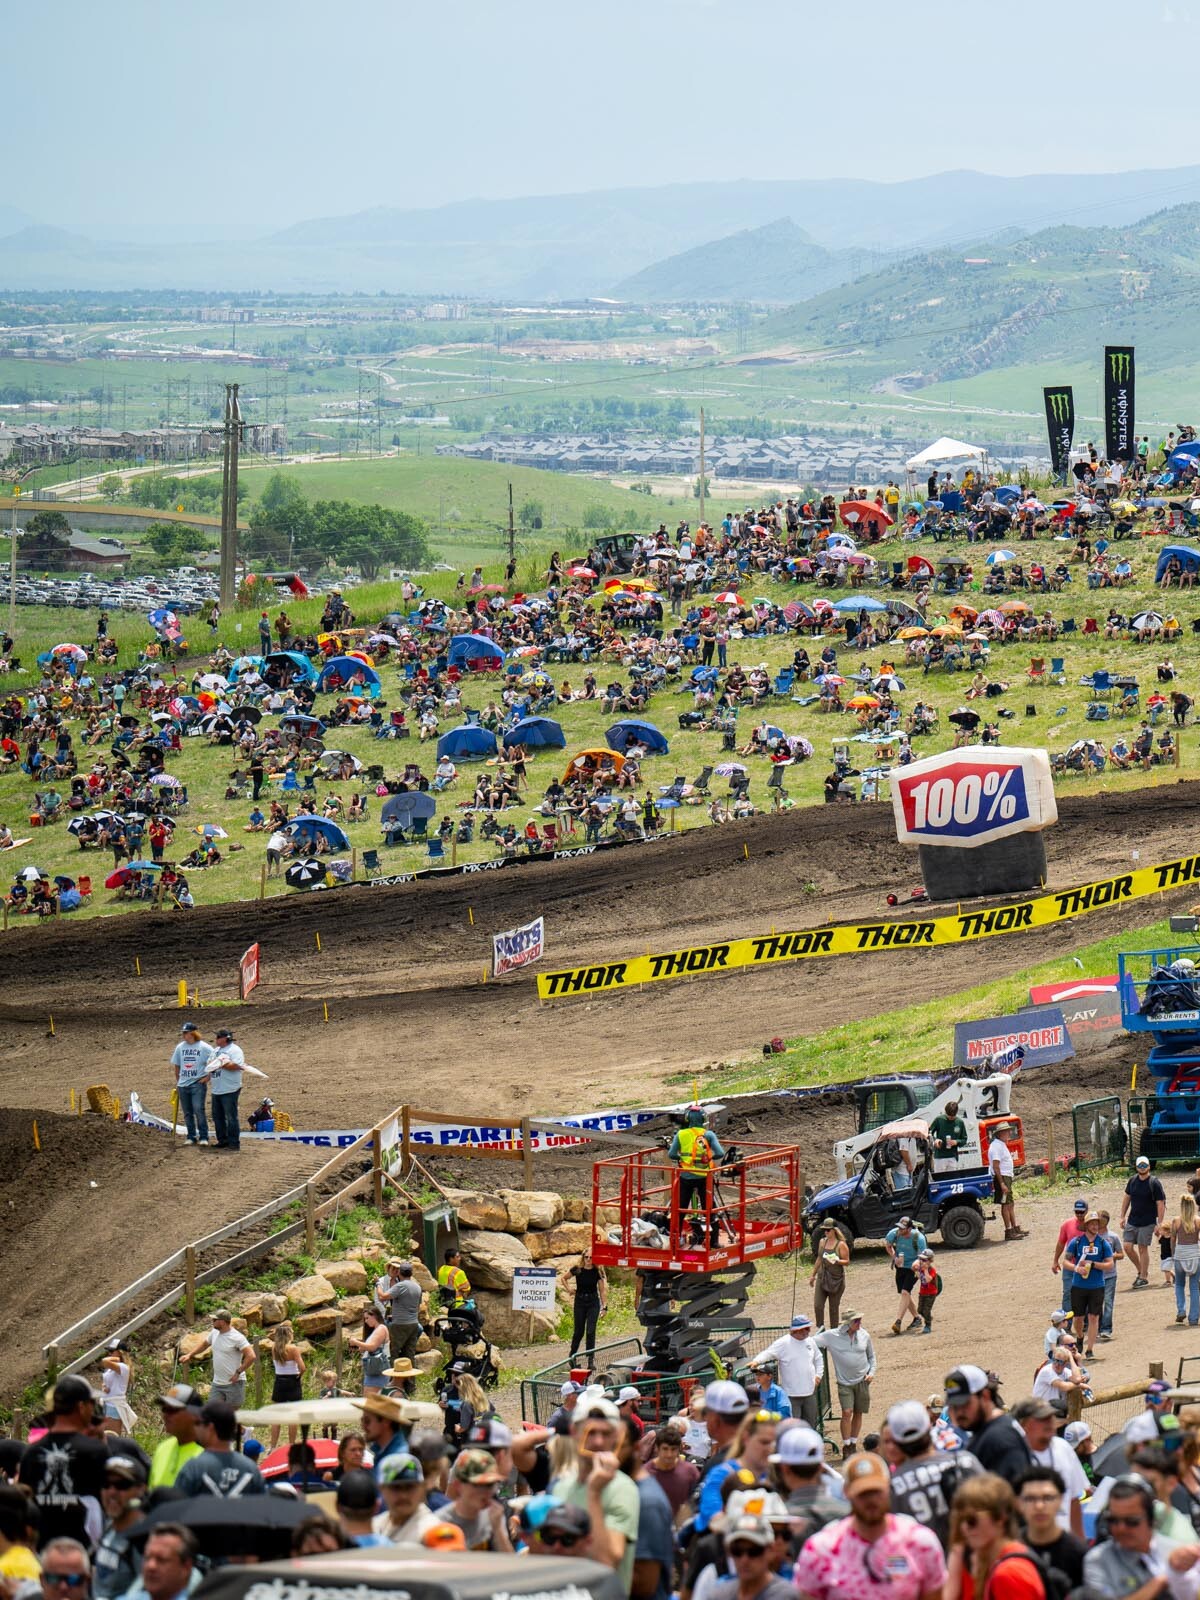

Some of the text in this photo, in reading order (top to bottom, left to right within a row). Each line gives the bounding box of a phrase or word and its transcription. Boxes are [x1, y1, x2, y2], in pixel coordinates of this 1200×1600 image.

[1118, 389, 1129, 451] MONSTER
[910, 769, 1016, 829] 100%
[554, 846, 597, 860] MX-ATV
[462, 860, 505, 873] MX-ATV
[370, 875, 414, 888] MX-ATV
[496, 922, 541, 957] PARTS
[545, 963, 628, 995] THOR
[649, 945, 730, 977] THOR
[752, 931, 833, 960] THOR
[857, 922, 936, 948] THOR
[958, 904, 1034, 936] THOR
[1055, 876, 1133, 916] THOR
[182, 1049, 201, 1057] TRACK
[181, 1069, 198, 1077] CREW
[950, 1183, 964, 1194] 28
